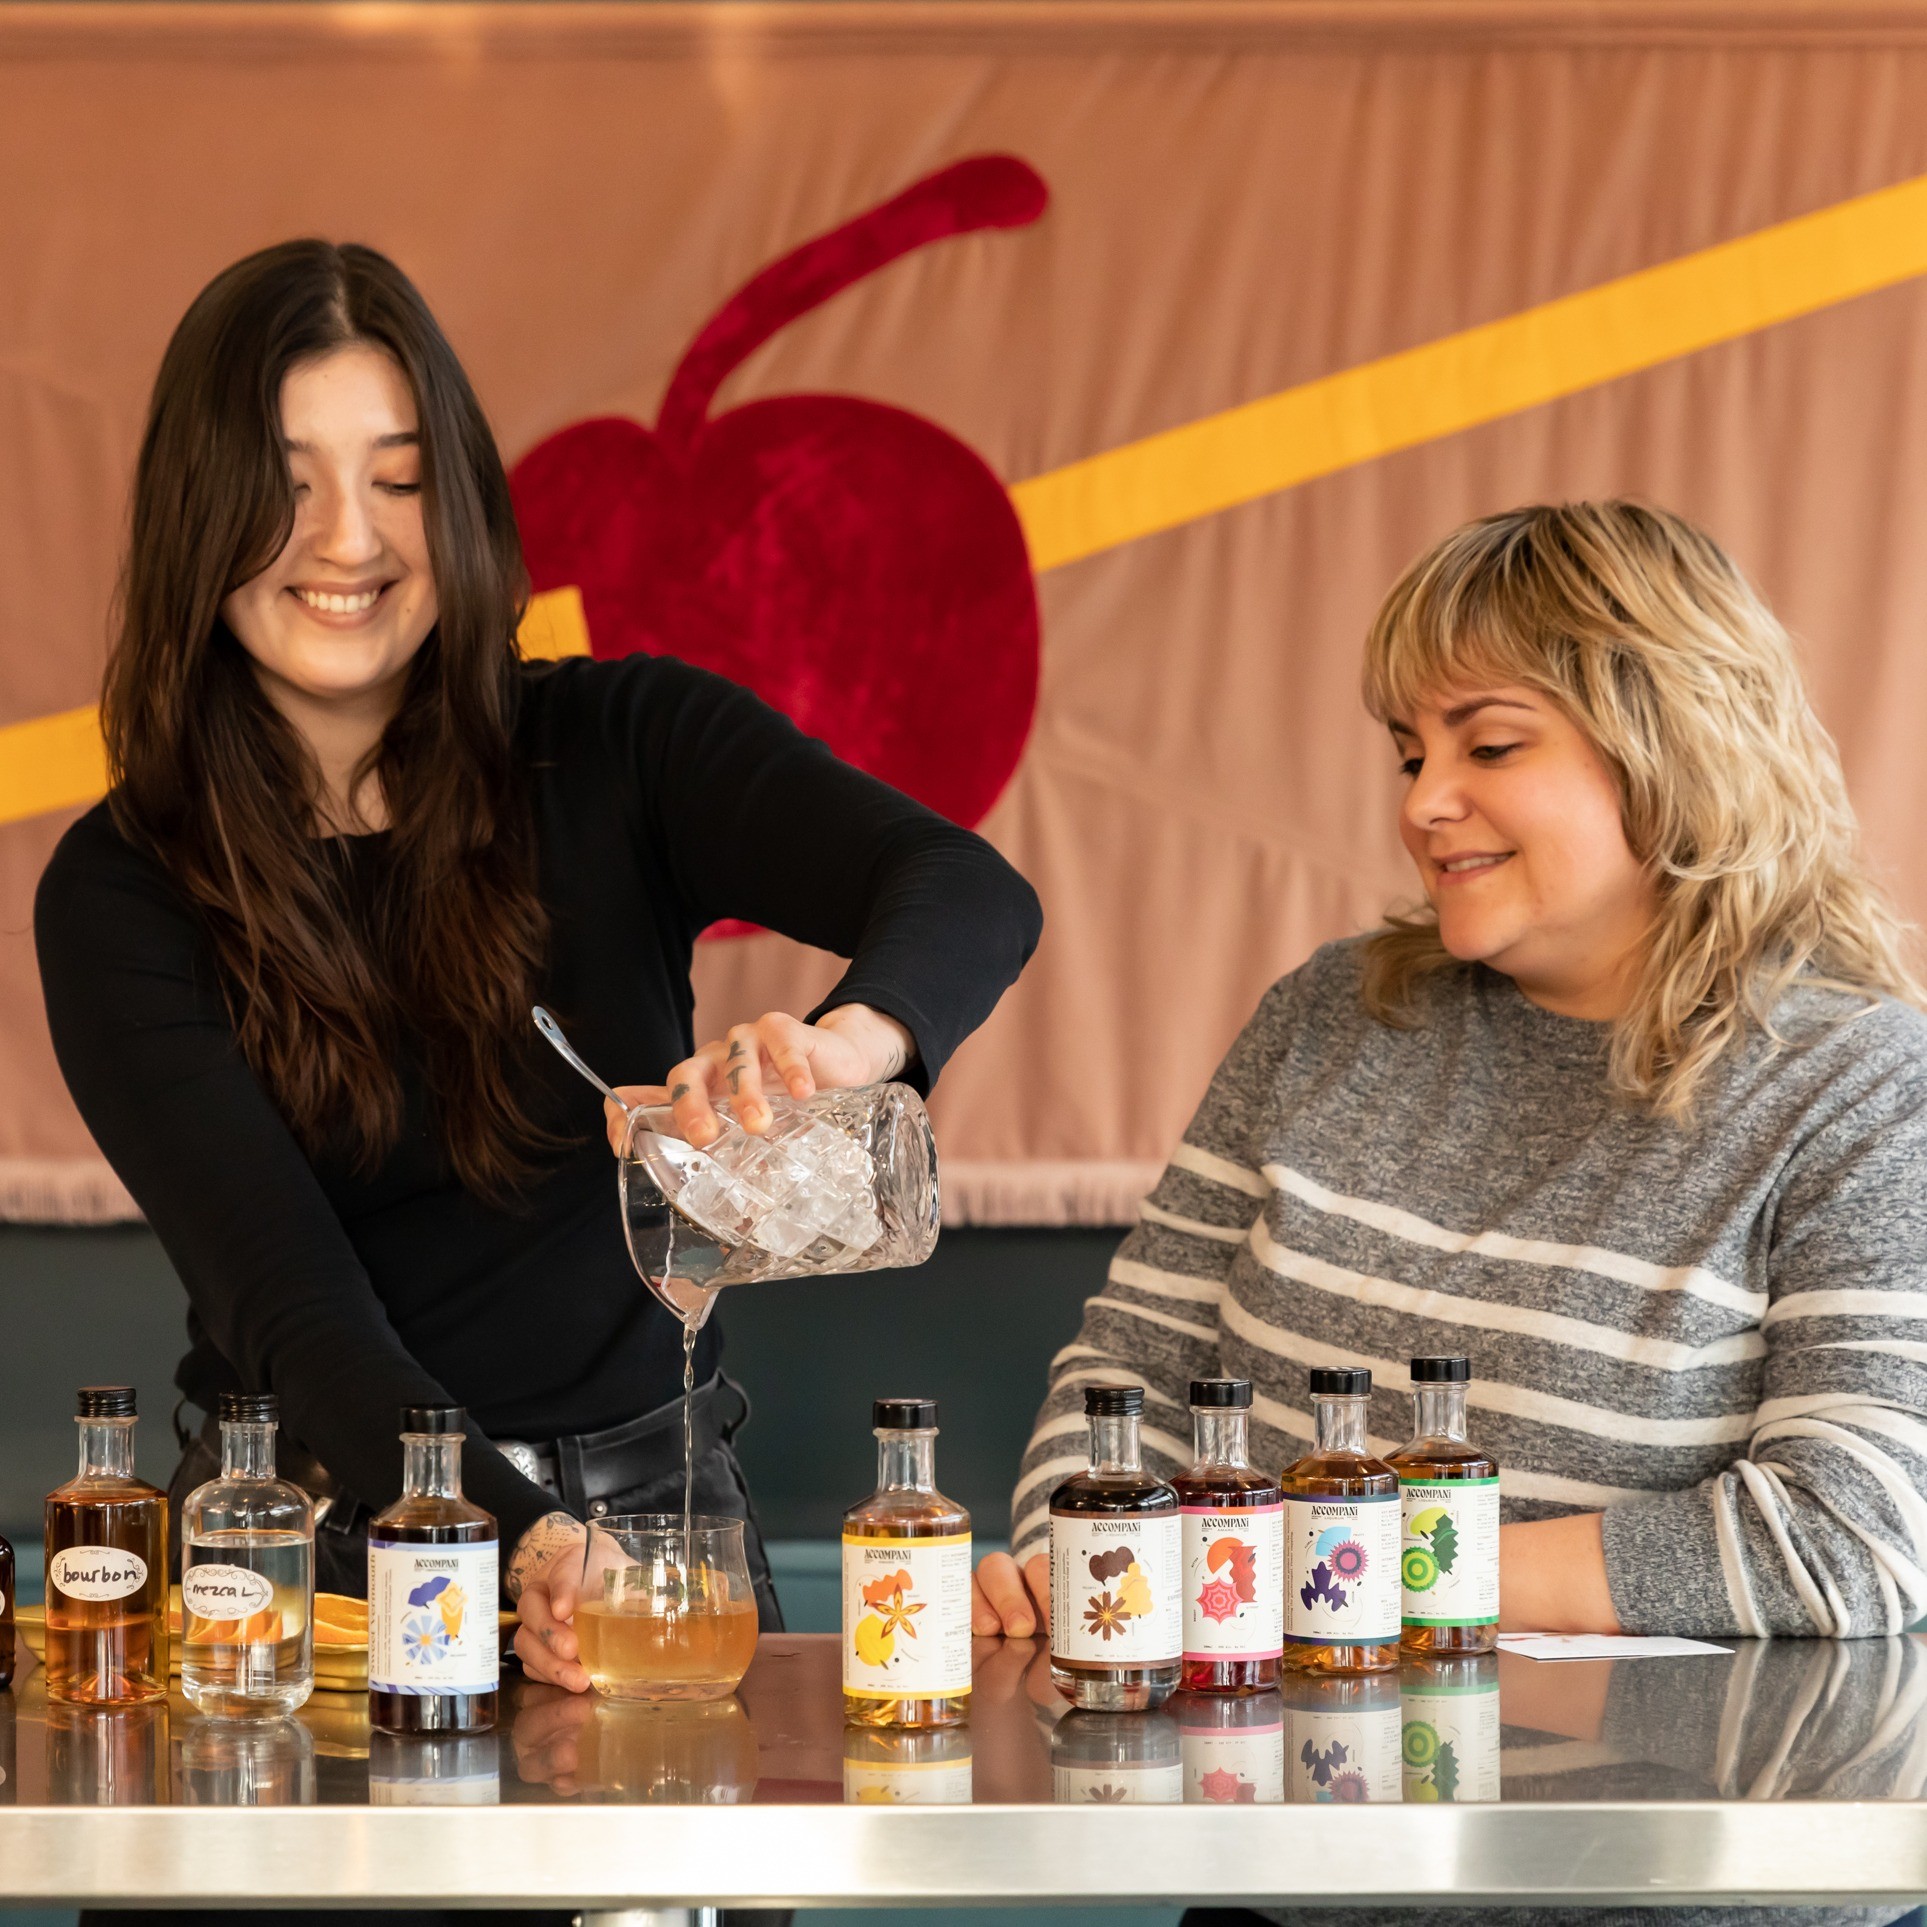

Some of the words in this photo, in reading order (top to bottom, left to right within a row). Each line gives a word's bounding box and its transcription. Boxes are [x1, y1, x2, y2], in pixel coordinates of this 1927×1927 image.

[1311, 1505, 1358, 1516] ACCOMPANi
[1201, 1517, 1250, 1528] ACCOMPANi
[62, 1562, 138, 1585] bourbon
